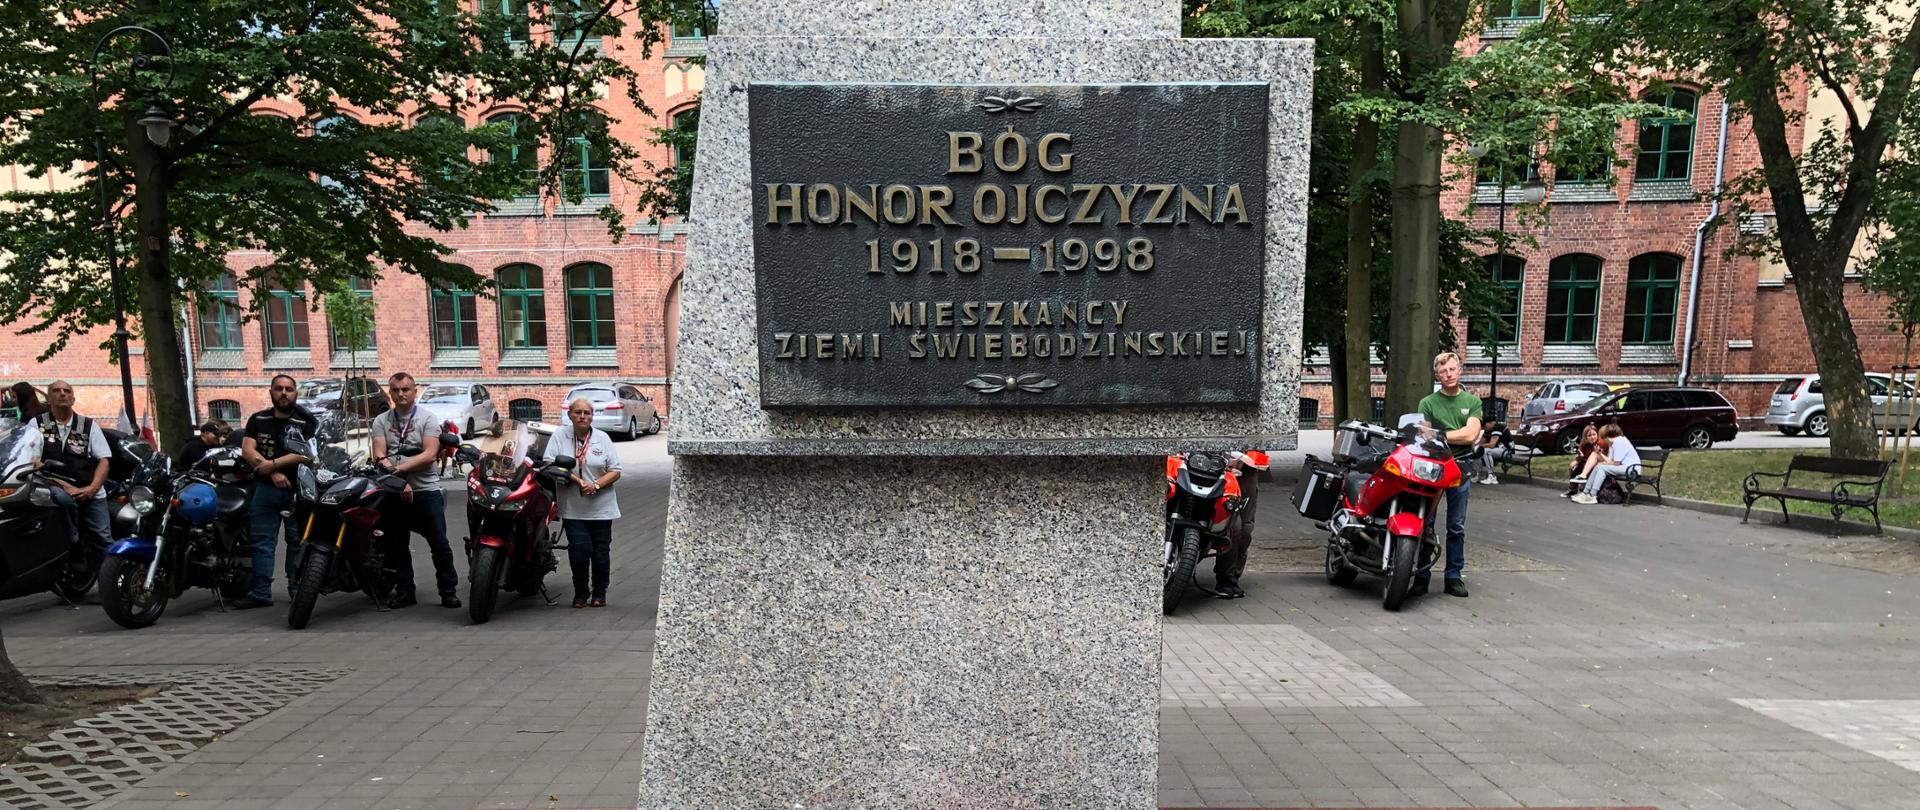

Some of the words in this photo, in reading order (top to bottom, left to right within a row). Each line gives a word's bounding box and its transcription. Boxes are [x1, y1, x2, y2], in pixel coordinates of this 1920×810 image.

[946, 125, 1075, 174] BÓG
[764, 183, 965, 226] HONOR
[973, 183, 1252, 227] OJCZYZNA
[774, 332, 881, 359] ZIEMI
